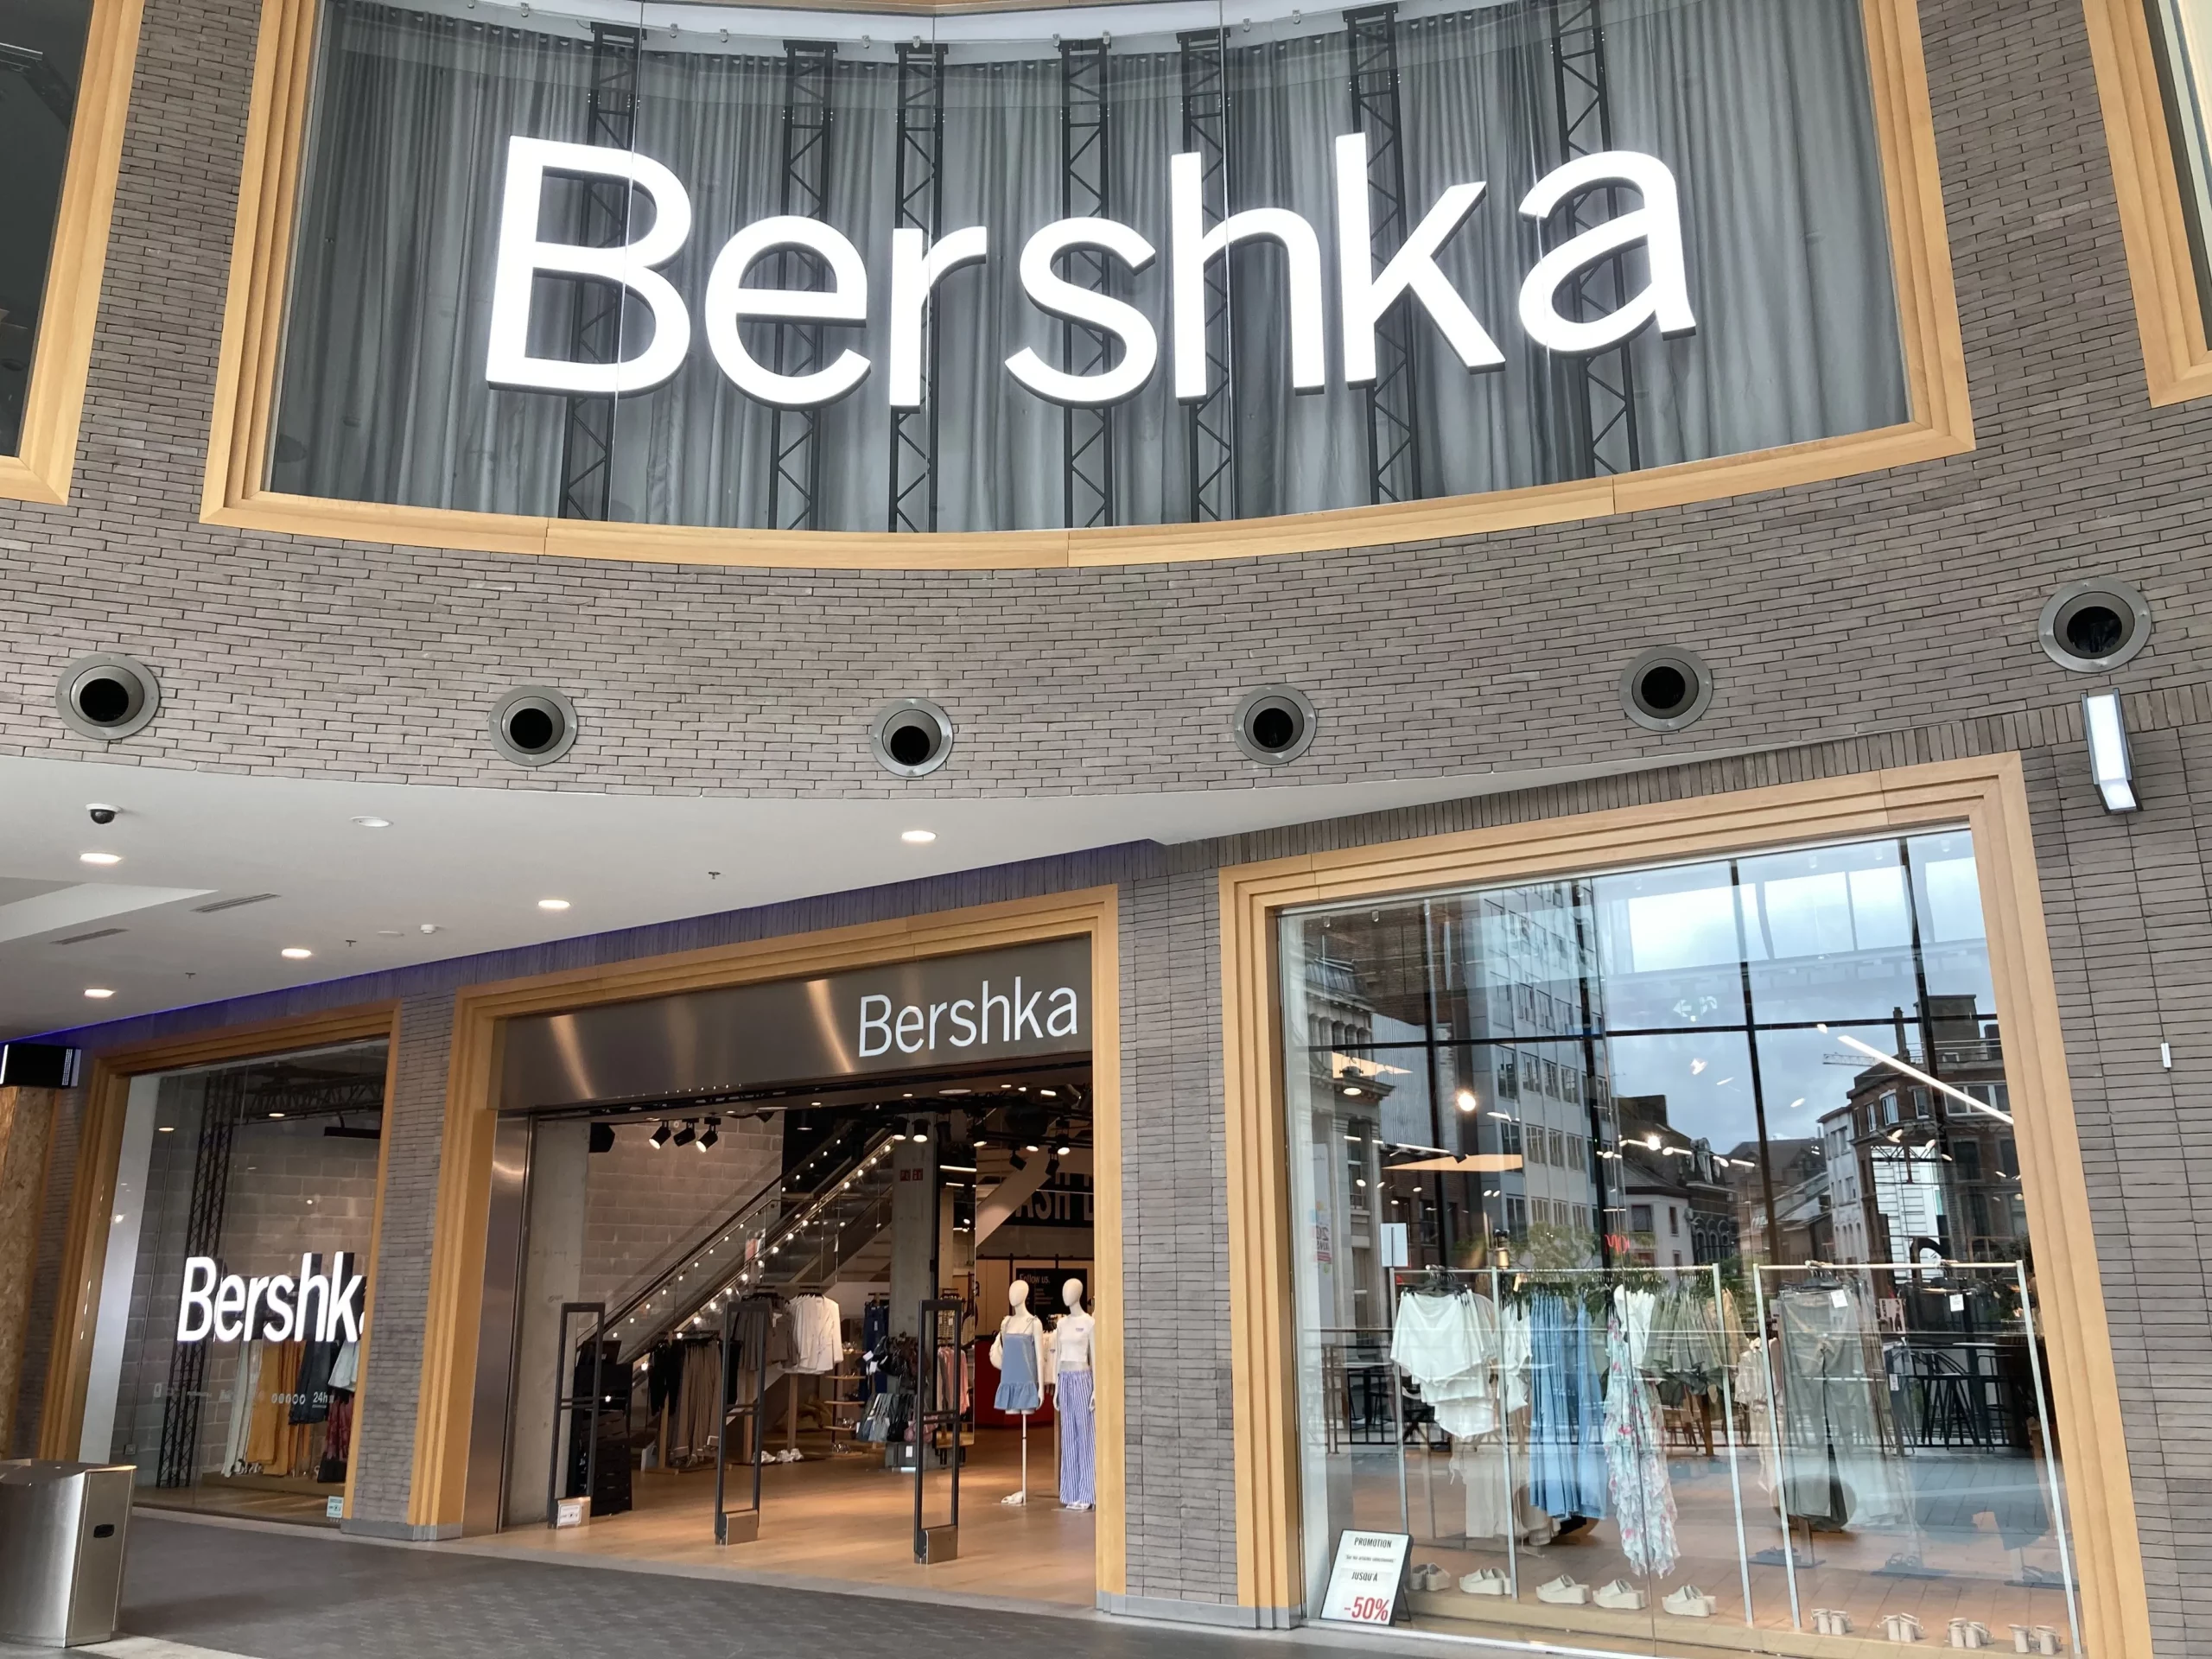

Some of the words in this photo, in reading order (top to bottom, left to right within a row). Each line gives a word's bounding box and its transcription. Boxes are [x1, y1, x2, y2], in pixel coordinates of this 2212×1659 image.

[486, 134, 1694, 410] Bershka
[859, 976, 1077, 1057] Bershka
[177, 1251, 365, 1342] Bershk
[1354, 1537, 1392, 1548] PROMOTION
[1344, 1596, 1389, 1621] -50%
